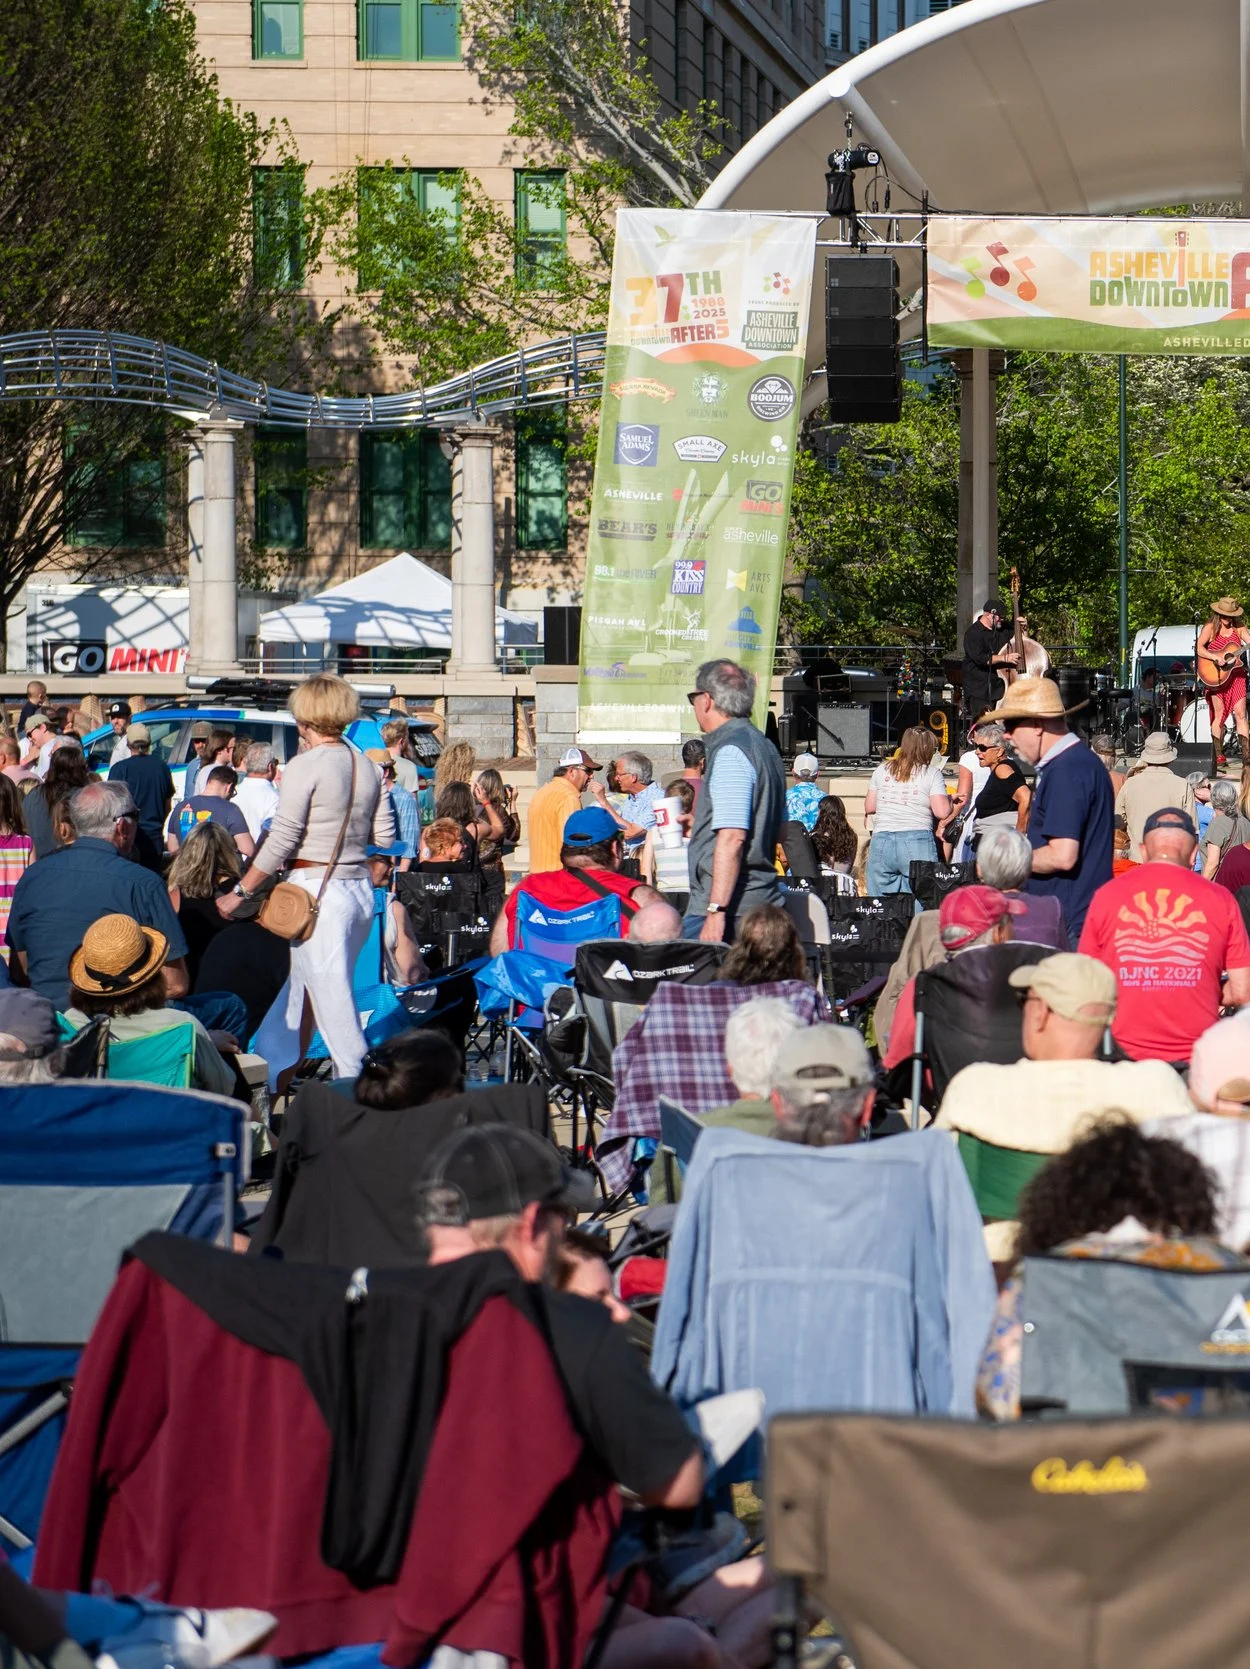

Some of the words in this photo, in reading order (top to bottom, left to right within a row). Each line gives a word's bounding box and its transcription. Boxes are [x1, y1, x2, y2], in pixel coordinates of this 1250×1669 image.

[1089, 250, 1229, 280] ASHEVILLE
[691, 297, 726, 308] 1988
[693, 308, 726, 319] 2025
[750, 311, 795, 328] ASHEVILLE
[744, 326, 798, 343] DOWNTOWN
[750, 393, 794, 403] BOOJUM
[619, 431, 655, 445] SAMUEL
[677, 438, 705, 450] SMALL
[706, 440, 723, 452] AXE
[621, 441, 651, 452] ADAMS
[731, 450, 776, 468] skyla
[750, 484, 782, 502] GO
[598, 519, 657, 535] BEAR'S
[723, 528, 779, 545] asheville
[594, 564, 614, 577] 98.1
[631, 568, 657, 579] RIVER
[675, 561, 694, 570] 99.9
[673, 569, 705, 582] KISS
[751, 571, 771, 584] ARTS
[672, 581, 703, 594] COUNTRY
[749, 582, 766, 594] AVL
[588, 615, 625, 626] PISGAH
[52, 645, 105, 673] GO
[425, 883, 448, 892] skyla
[856, 906, 878, 915] skyla
[547, 916, 572, 926] OZARK
[571, 912, 594, 924] TRAIL
[461, 925, 483, 935] skyla
[632, 970, 666, 979] OZARK
[666, 964, 695, 977] TRAIL
[1164, 967, 1203, 981] 2021
